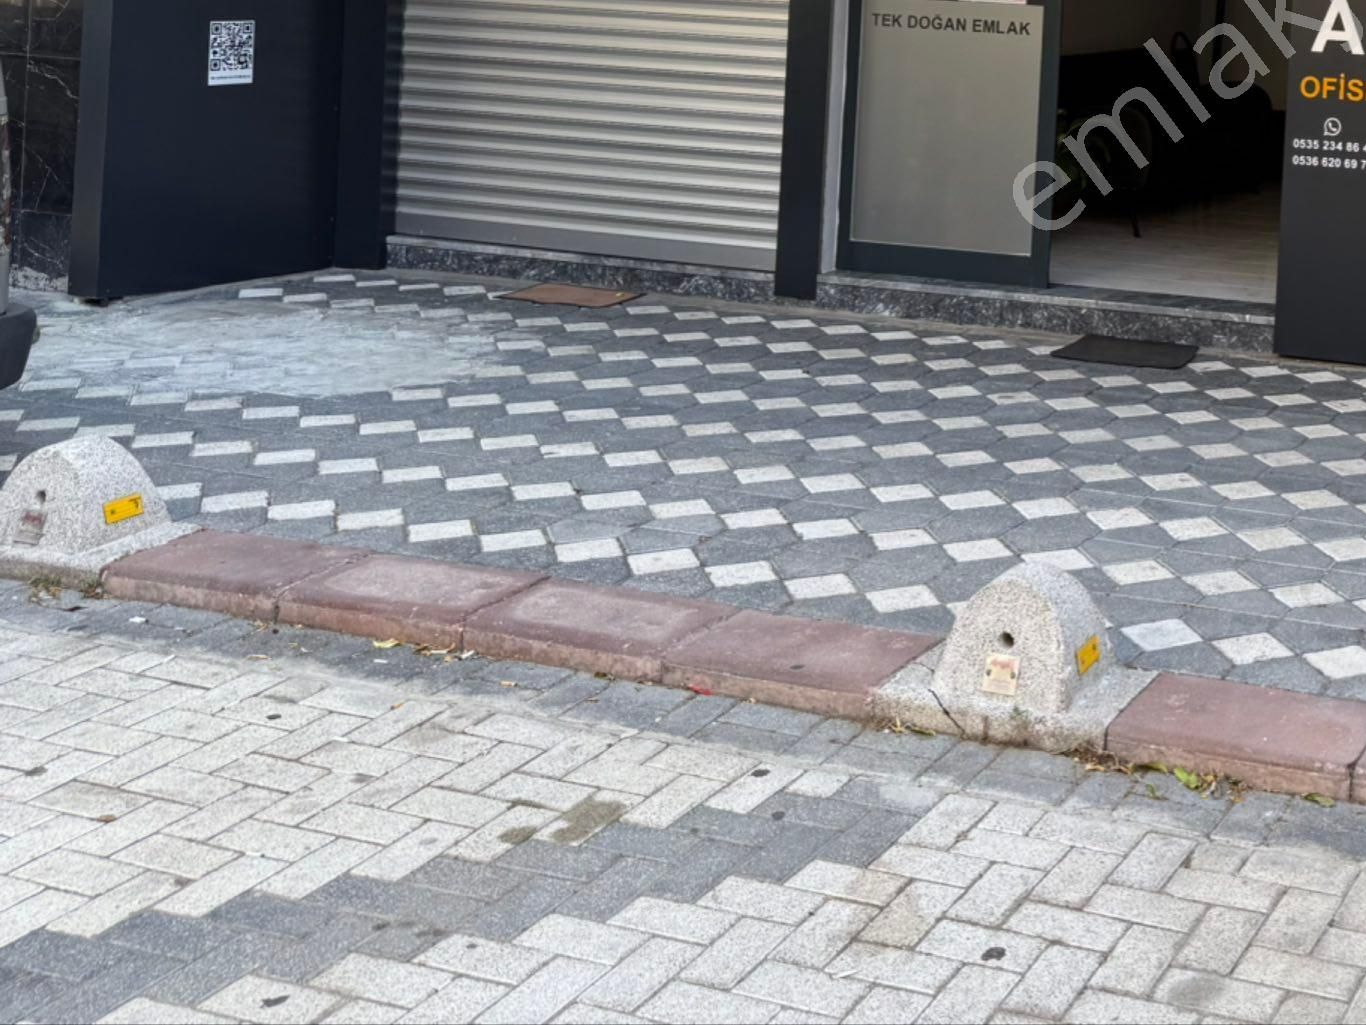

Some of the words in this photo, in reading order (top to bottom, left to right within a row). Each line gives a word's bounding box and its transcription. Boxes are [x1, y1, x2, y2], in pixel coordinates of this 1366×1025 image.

[872, 12, 903, 27] TEK
[907, 12, 967, 32] DOĞAN
[972, 19, 1031, 36] EMLAK
[1292, 138, 1320, 150] 0535
[1322, 140, 1343, 151] 234
[1345, 142, 1360, 153] 86
[1292, 154, 1319, 166] 0536
[1321, 157, 1342, 168] 620
[1344, 158, 1358, 169] 69
